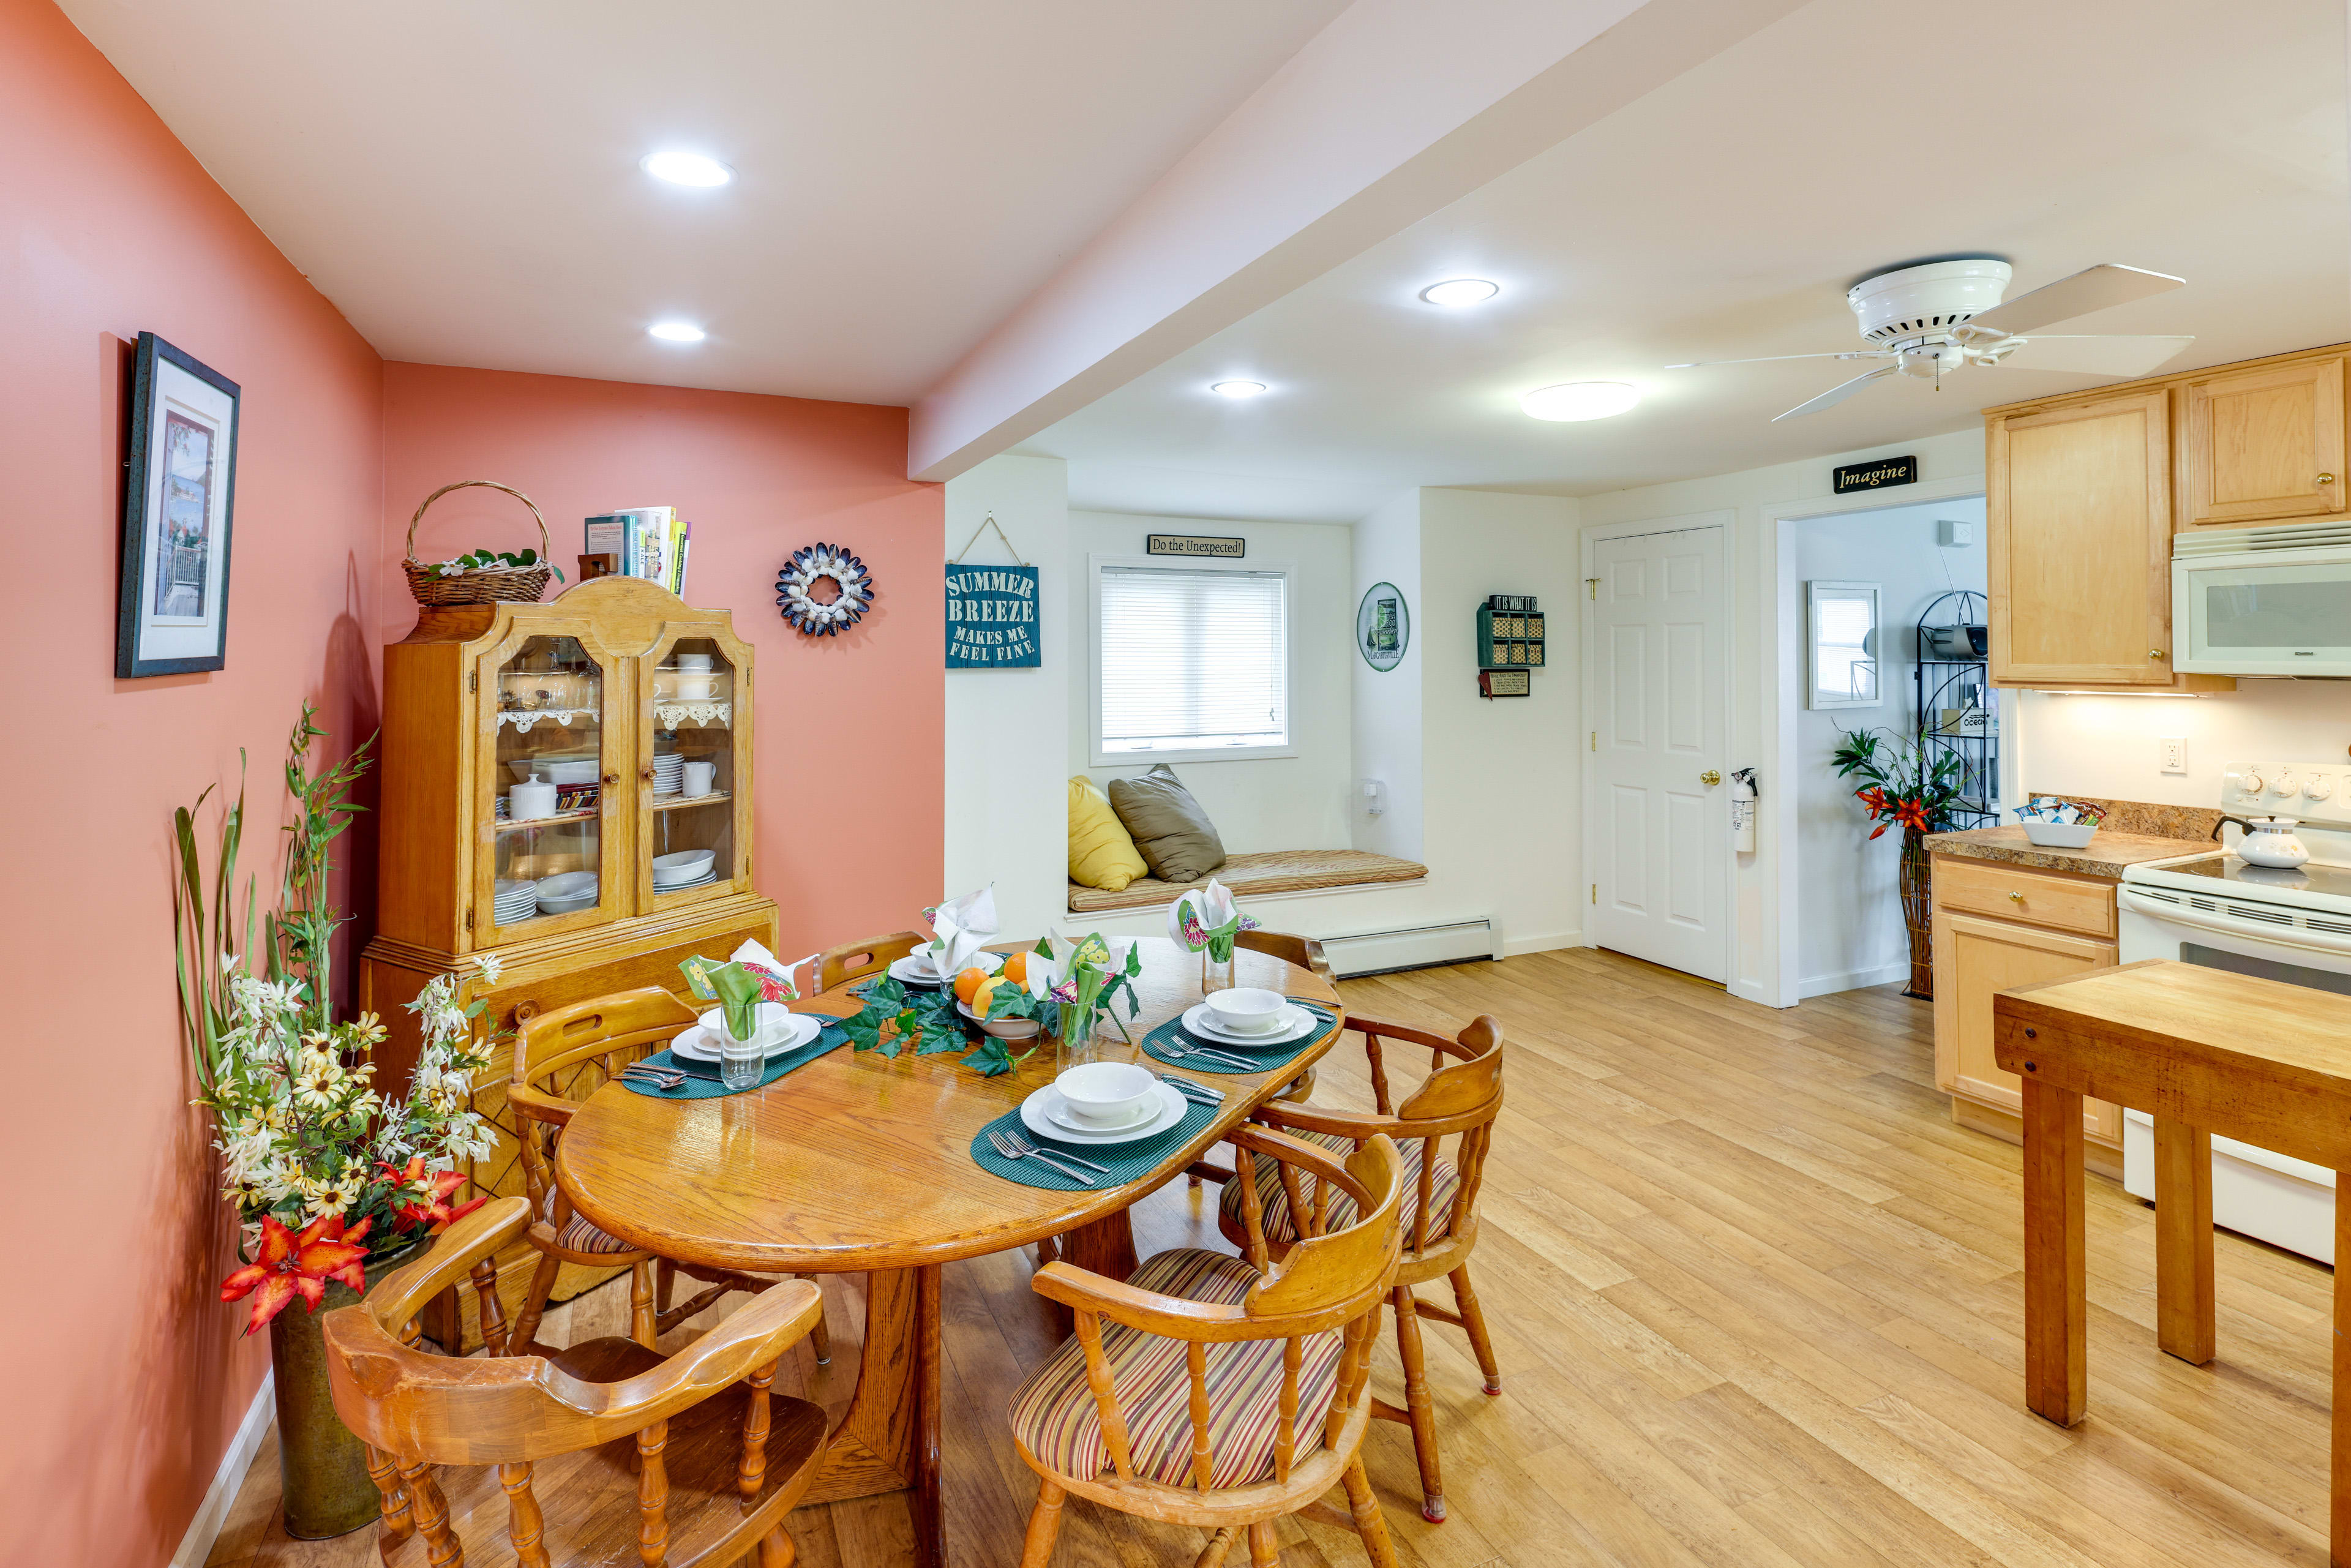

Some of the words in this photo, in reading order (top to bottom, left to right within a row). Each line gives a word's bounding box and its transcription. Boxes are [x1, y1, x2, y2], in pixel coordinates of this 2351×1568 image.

[1839, 464, 1907, 489] Imagine
[1153, 539, 1166, 550] Do
[1169, 538, 1183, 550] the
[1186, 540, 1241, 555] Unexpected!
[946, 572, 1034, 599] SUMMER
[948, 599, 1034, 622] BREEZE
[1496, 596, 1501, 610] IT
[1502, 596, 1508, 610] IS
[1509, 596, 1524, 610] WHAT
[1525, 597, 1531, 610] IT
[1531, 597, 1537, 611] IS
[954, 626, 1002, 645] MAKES
[1006, 625, 1027, 642] ME
[950, 642, 989, 661] FEEL
[997, 640, 1035, 661] FINE
